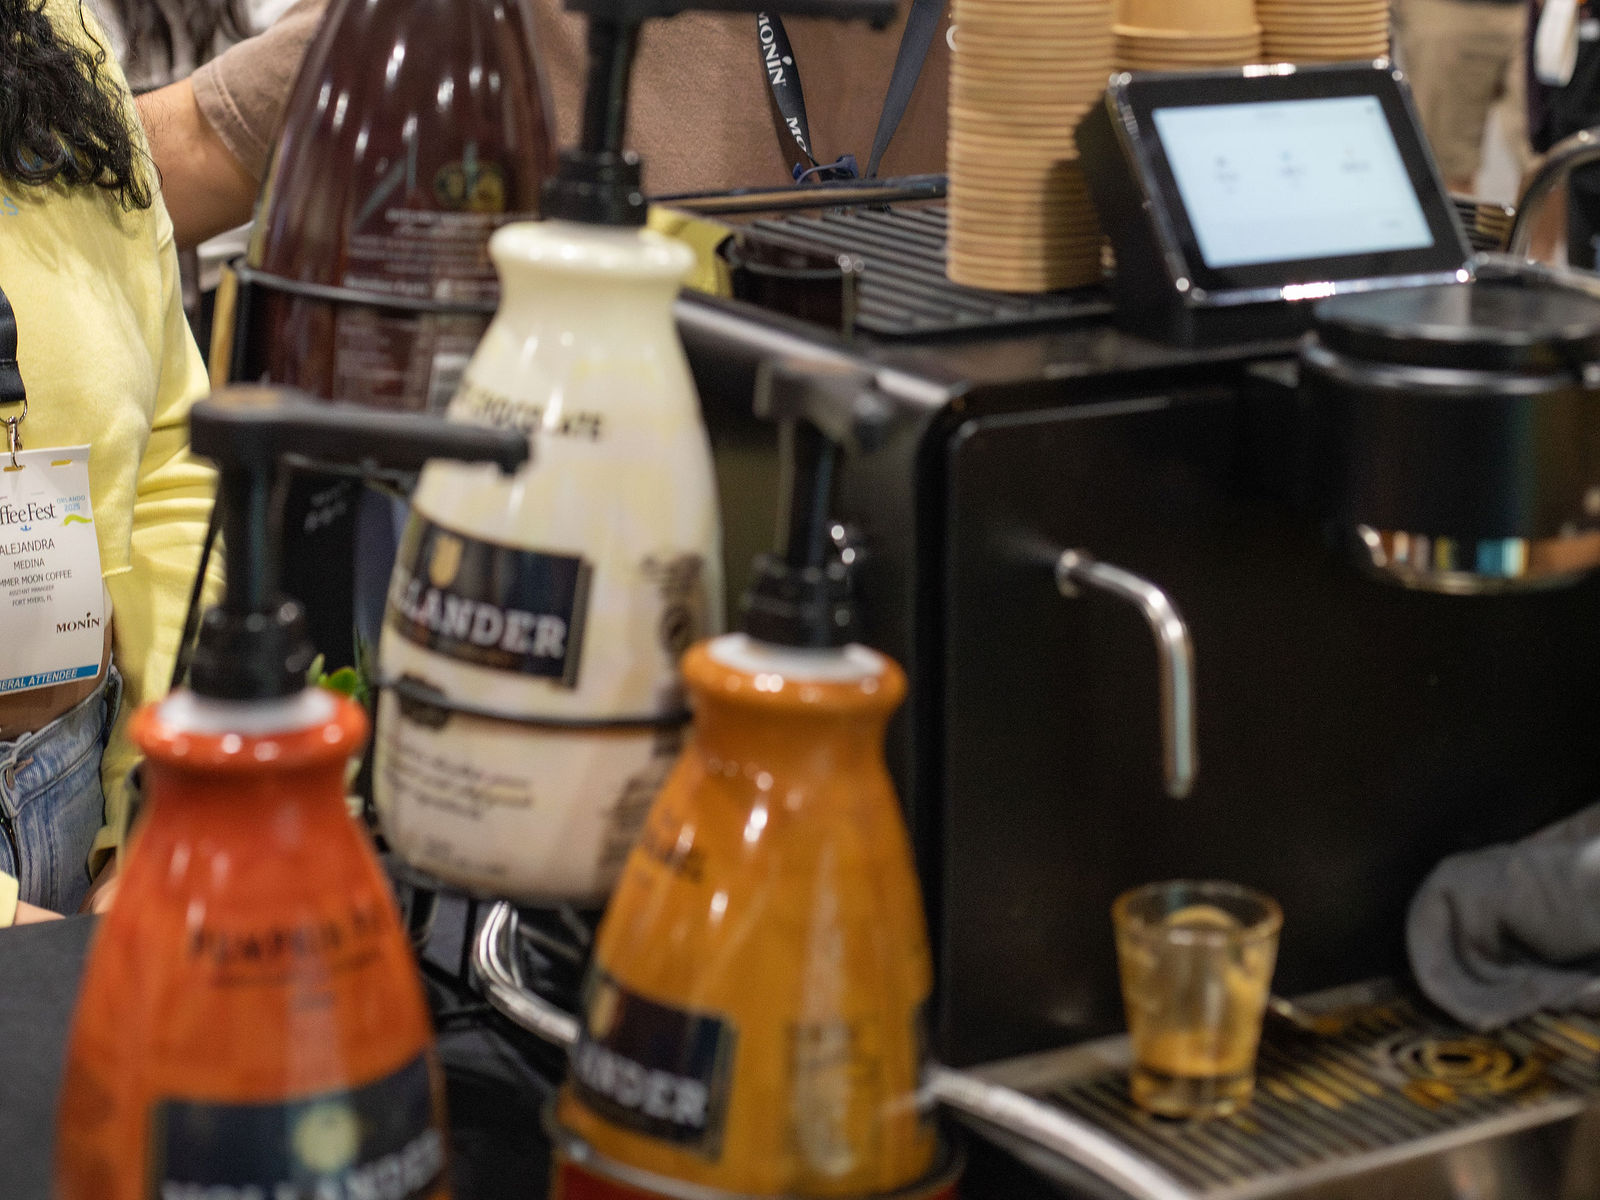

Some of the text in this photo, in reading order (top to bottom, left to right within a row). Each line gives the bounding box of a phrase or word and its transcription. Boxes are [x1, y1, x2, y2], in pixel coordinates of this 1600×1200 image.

[0, 538, 56, 556] ALEJANDRA
[13, 558, 46, 571] MEDINA
[21, 573, 44, 585] MOON
[45, 569, 72, 582] COFFEE
[56, 612, 100, 634] MONIN
[0, 669, 78, 691] ERAL ATTENDEE
